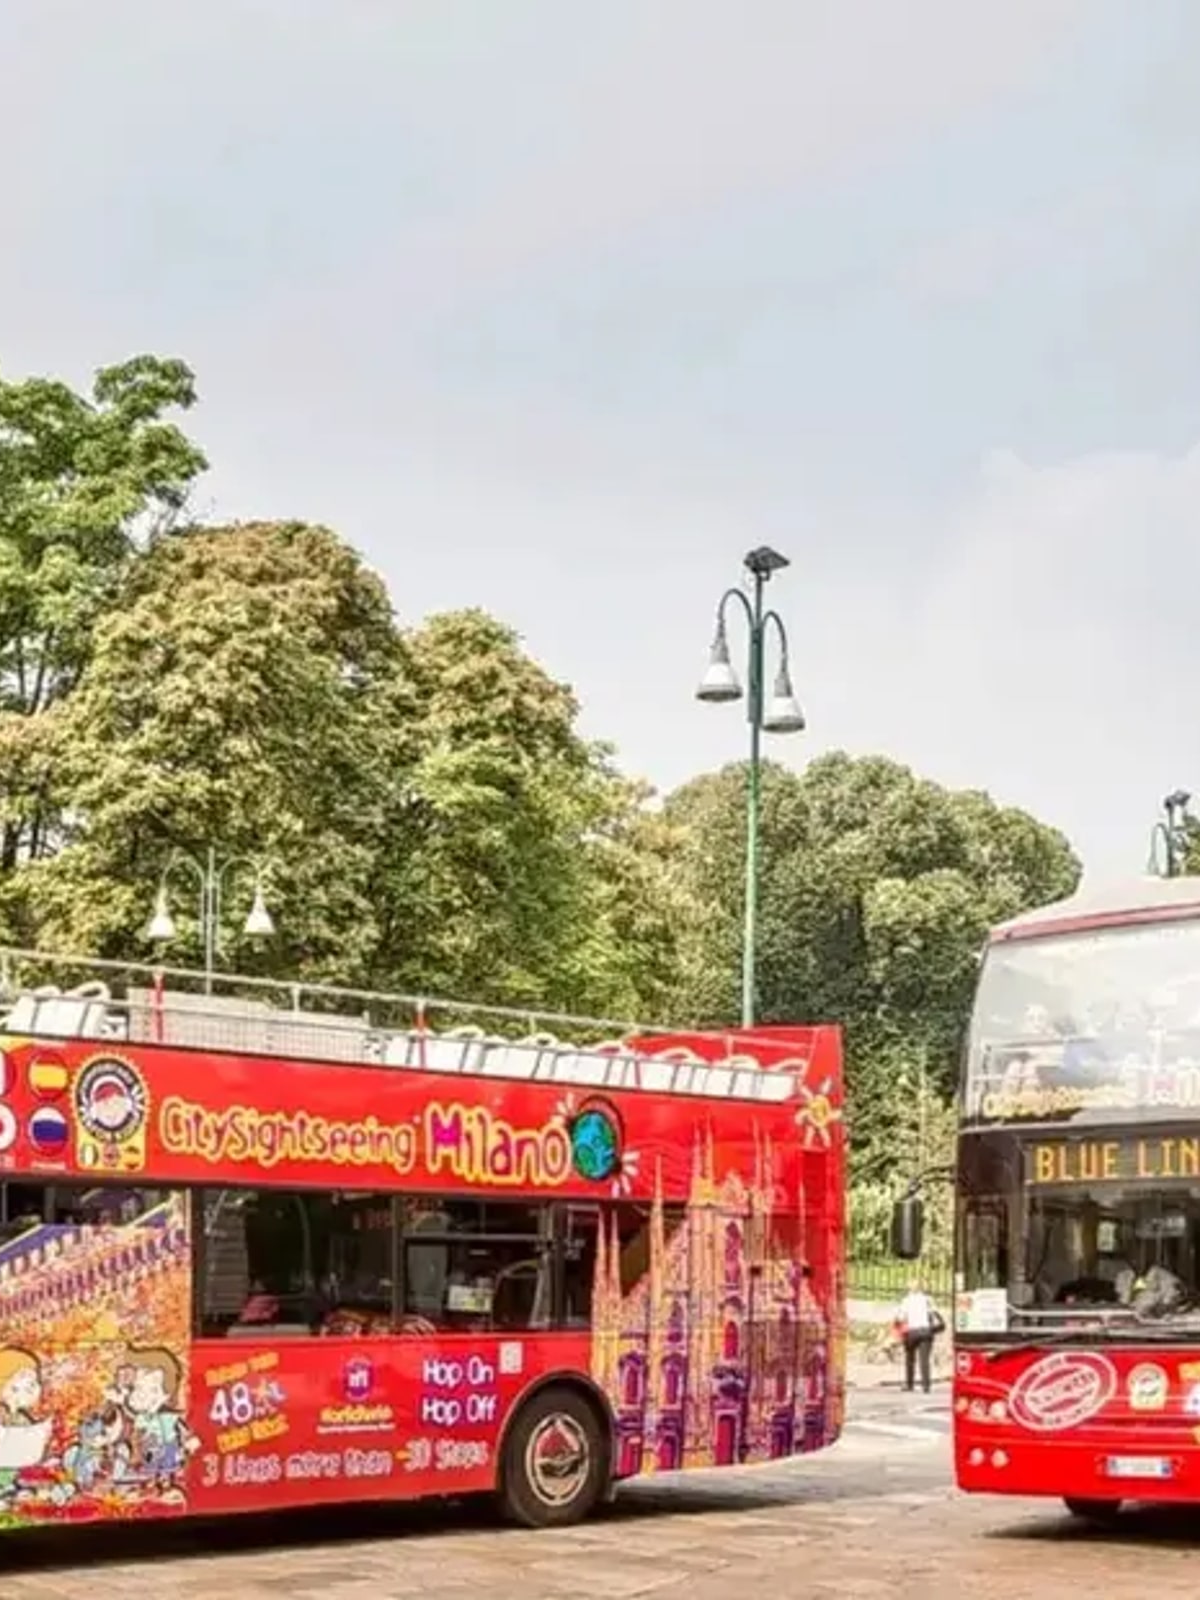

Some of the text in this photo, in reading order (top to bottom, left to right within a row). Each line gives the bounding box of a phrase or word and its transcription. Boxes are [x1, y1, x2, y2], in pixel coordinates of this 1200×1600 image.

[160, 1096, 415, 1175] CitySightseeing
[426, 1103, 572, 1185] Milano
[1035, 1143, 1119, 1184] BLUE
[422, 1355, 494, 1388] Hop On
[210, 1382, 253, 1426] 48
[422, 1396, 461, 1426] Hop
[466, 1393, 498, 1422] Off
